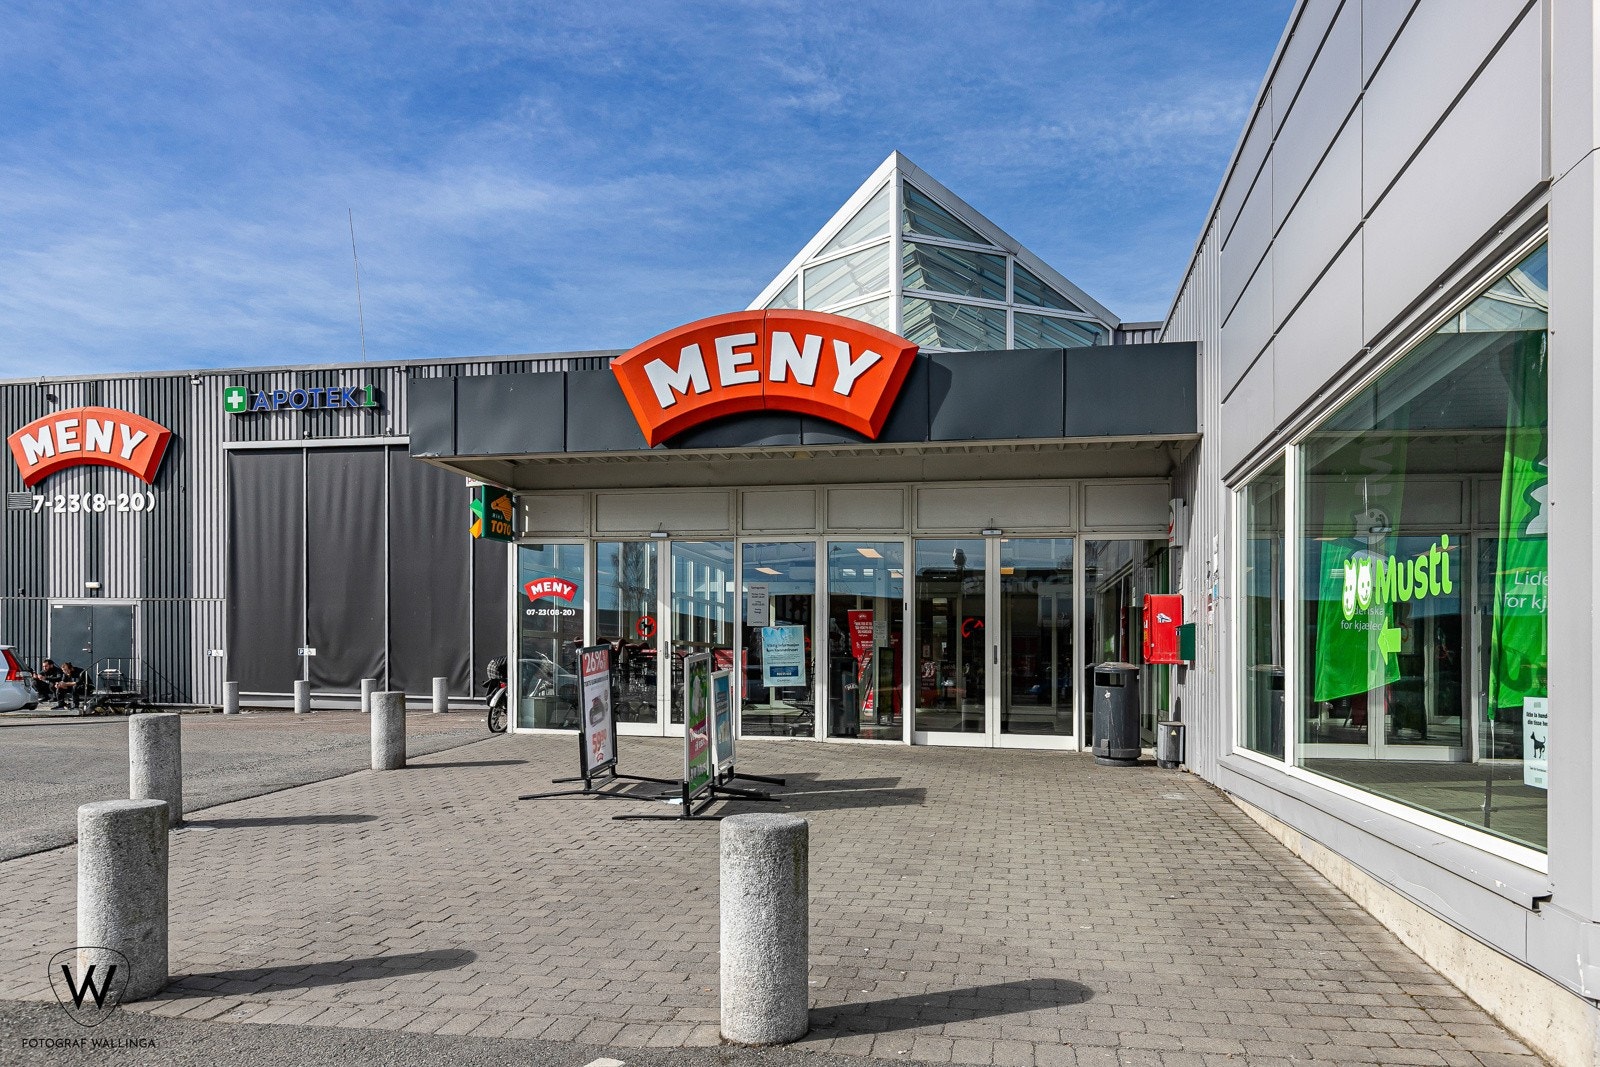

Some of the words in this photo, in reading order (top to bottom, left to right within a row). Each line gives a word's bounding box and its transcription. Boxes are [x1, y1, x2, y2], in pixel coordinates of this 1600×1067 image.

[643, 331, 881, 409] MENY
[251, 386, 359, 411] APOTEK
[363, 384, 377, 407] 1
[20, 418, 148, 466] MENY
[32, 491, 155, 513] 7-23(8-20)
[491, 520, 511, 536] TOTO
[1375, 534, 1453, 605] Musti
[530, 581, 572, 596] MENY
[1503, 592, 1527, 608] for
[1341, 620, 1353, 630] for
[584, 650, 604, 673] 26%
